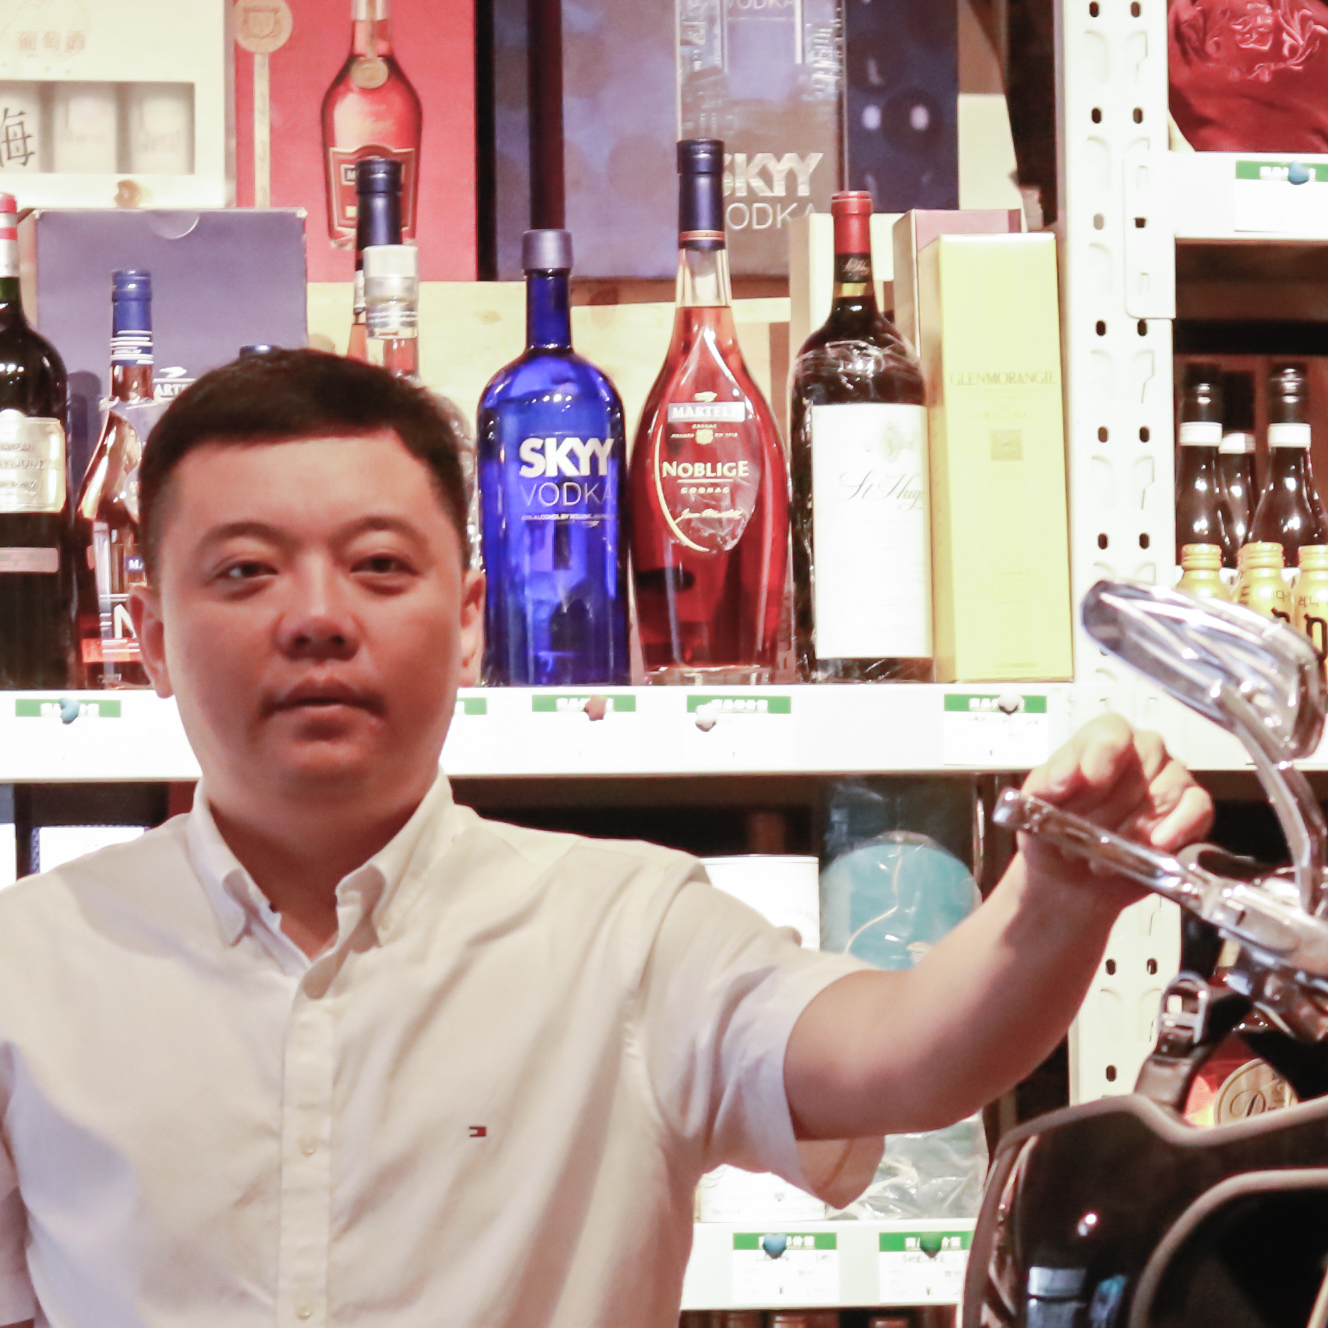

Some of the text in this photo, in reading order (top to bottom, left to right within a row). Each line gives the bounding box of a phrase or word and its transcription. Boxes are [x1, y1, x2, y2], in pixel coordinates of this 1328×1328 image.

[950, 372, 1056, 386] GLENMORANGIE
[519, 437, 615, 477] SKYY
[662, 461, 749, 478] NOBLIGE
[519, 482, 616, 507] VODKA
